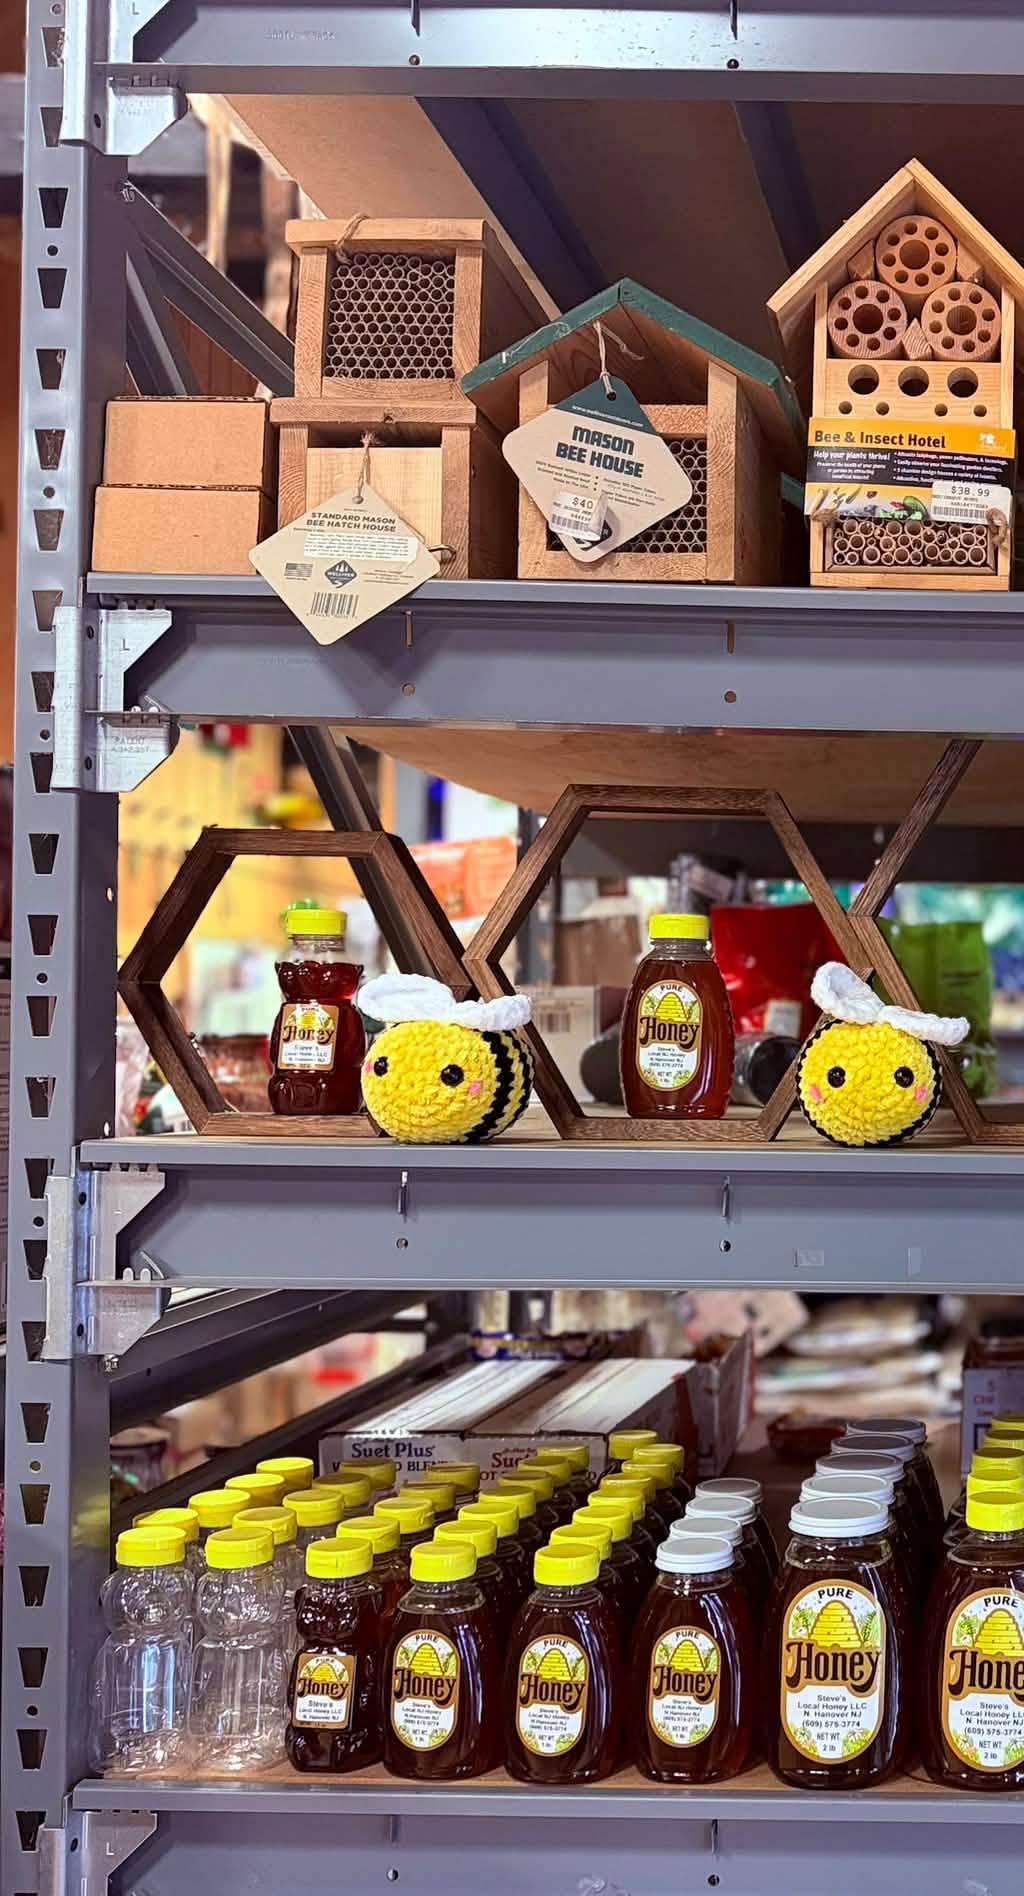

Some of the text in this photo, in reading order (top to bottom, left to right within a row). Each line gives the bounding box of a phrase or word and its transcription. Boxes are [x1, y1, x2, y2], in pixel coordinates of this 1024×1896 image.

[571, 425, 635, 455] MASON
[814, 430, 946, 449] Bee & Insect Hotel
[556, 441, 587, 464] BEE
[590, 450, 645, 478] HOUSE
[813, 450, 829, 460] Help
[829, 451, 846, 460] your
[846, 451, 867, 461] plants
[951, 485, 991, 497] $38.99
[571, 495, 595, 510] $40
[311, 511, 396, 525] STANDARD MASON
[306, 518, 397, 533] BEE HATCH HOUSE
[640, 1015, 700, 1049] Honey
[351, 1442, 433, 1458] Suet Plus
[817, 1587, 854, 1600] PURE
[983, 1595, 1019, 1608] PURE
[785, 1640, 882, 1693] Honey
[297, 1678, 350, 1700] Honey
[393, 1668, 457, 1706] Honey
[653, 1665, 718, 1701] Honey
[519, 1672, 586, 1711] Honey
[817, 1694, 847, 1702] Steve's
[797, 1701, 868, 1711] Local Honey LLC
[979, 1702, 1009, 1710] Steve's
[960, 1709, 983, 1717] Local
[984, 1710, 1010, 1719] Honey
[802, 1720, 822, 1728] (609)
[816, 1732, 830, 1740] NET
[964, 1727, 984, 1736] (609)
[978, 1740, 992, 1748] NET
[105, 1842, 115, 1856] L
